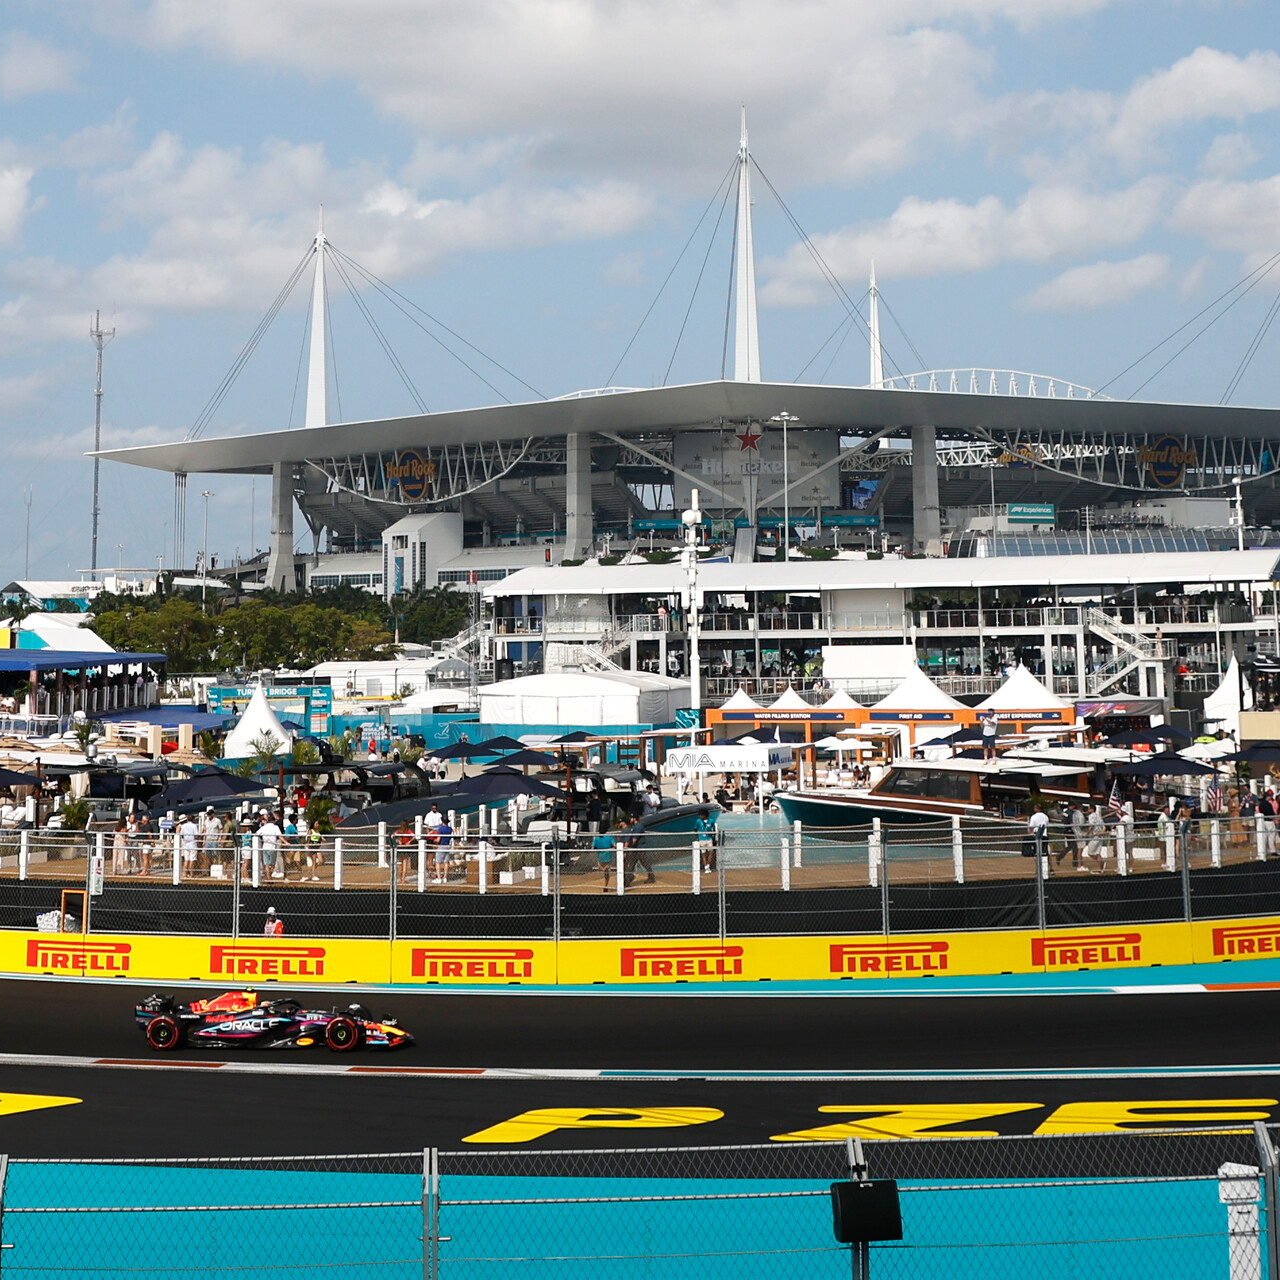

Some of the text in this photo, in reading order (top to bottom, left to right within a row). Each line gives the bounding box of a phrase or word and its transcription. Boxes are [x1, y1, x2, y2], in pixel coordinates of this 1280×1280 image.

[386, 459, 437, 480] Hard Rock
[1137, 445, 1197, 467] Hard Rock
[237, 688, 256, 696] TURN
[27, 940, 131, 971] PIRELLI
[211, 946, 325, 976] PIRELLI
[412, 949, 533, 977] PIRELLI
[621, 946, 743, 976] PIRELLI
[830, 942, 948, 973] PIRELLI
[1032, 933, 1141, 965] PIRELLI
[220, 1018, 279, 1031] ORACLE
[462, 1106, 725, 1144] P
